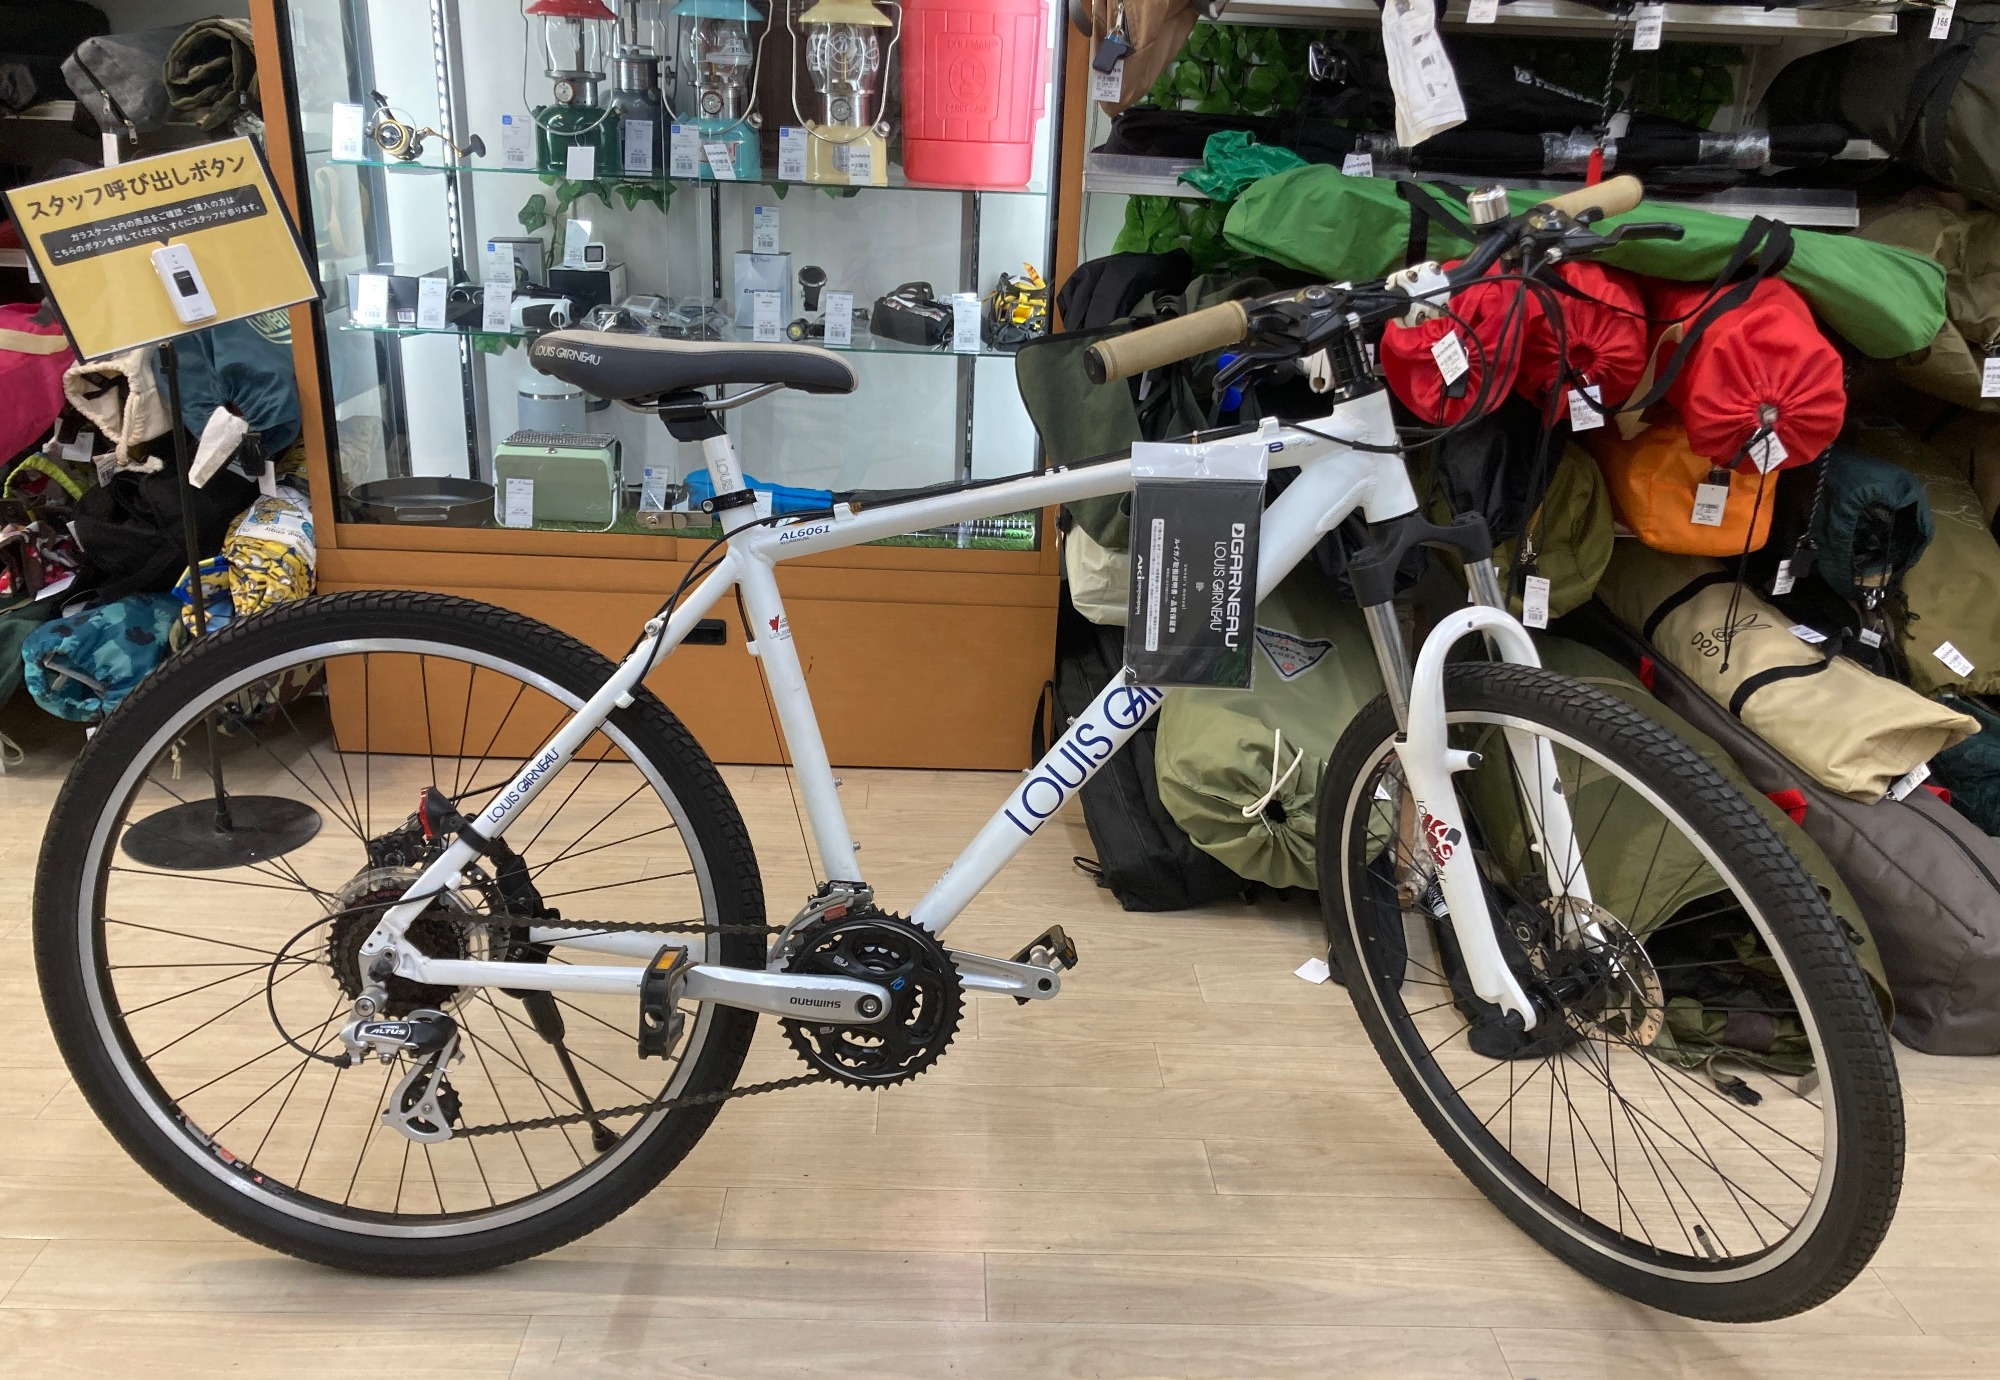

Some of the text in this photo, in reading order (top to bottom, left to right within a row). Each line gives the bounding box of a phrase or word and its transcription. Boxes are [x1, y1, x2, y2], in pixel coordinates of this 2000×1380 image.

[27, 155, 245, 221] スタッフ呼び出しボタン
[535, 345, 601, 366] LOUIS GARNEAU
[779, 525, 830, 541] AL6061
[1210, 541, 1228, 632] LOUIS GARNEAU
[1224, 538, 1245, 648] GARNEAU
[486, 747, 559, 824] LOUIS GARNEAU
[1003, 723, 1114, 837] LOUIS
[370, 1028, 407, 1036] ALTUS
[789, 996, 842, 1009] SHIMANO
